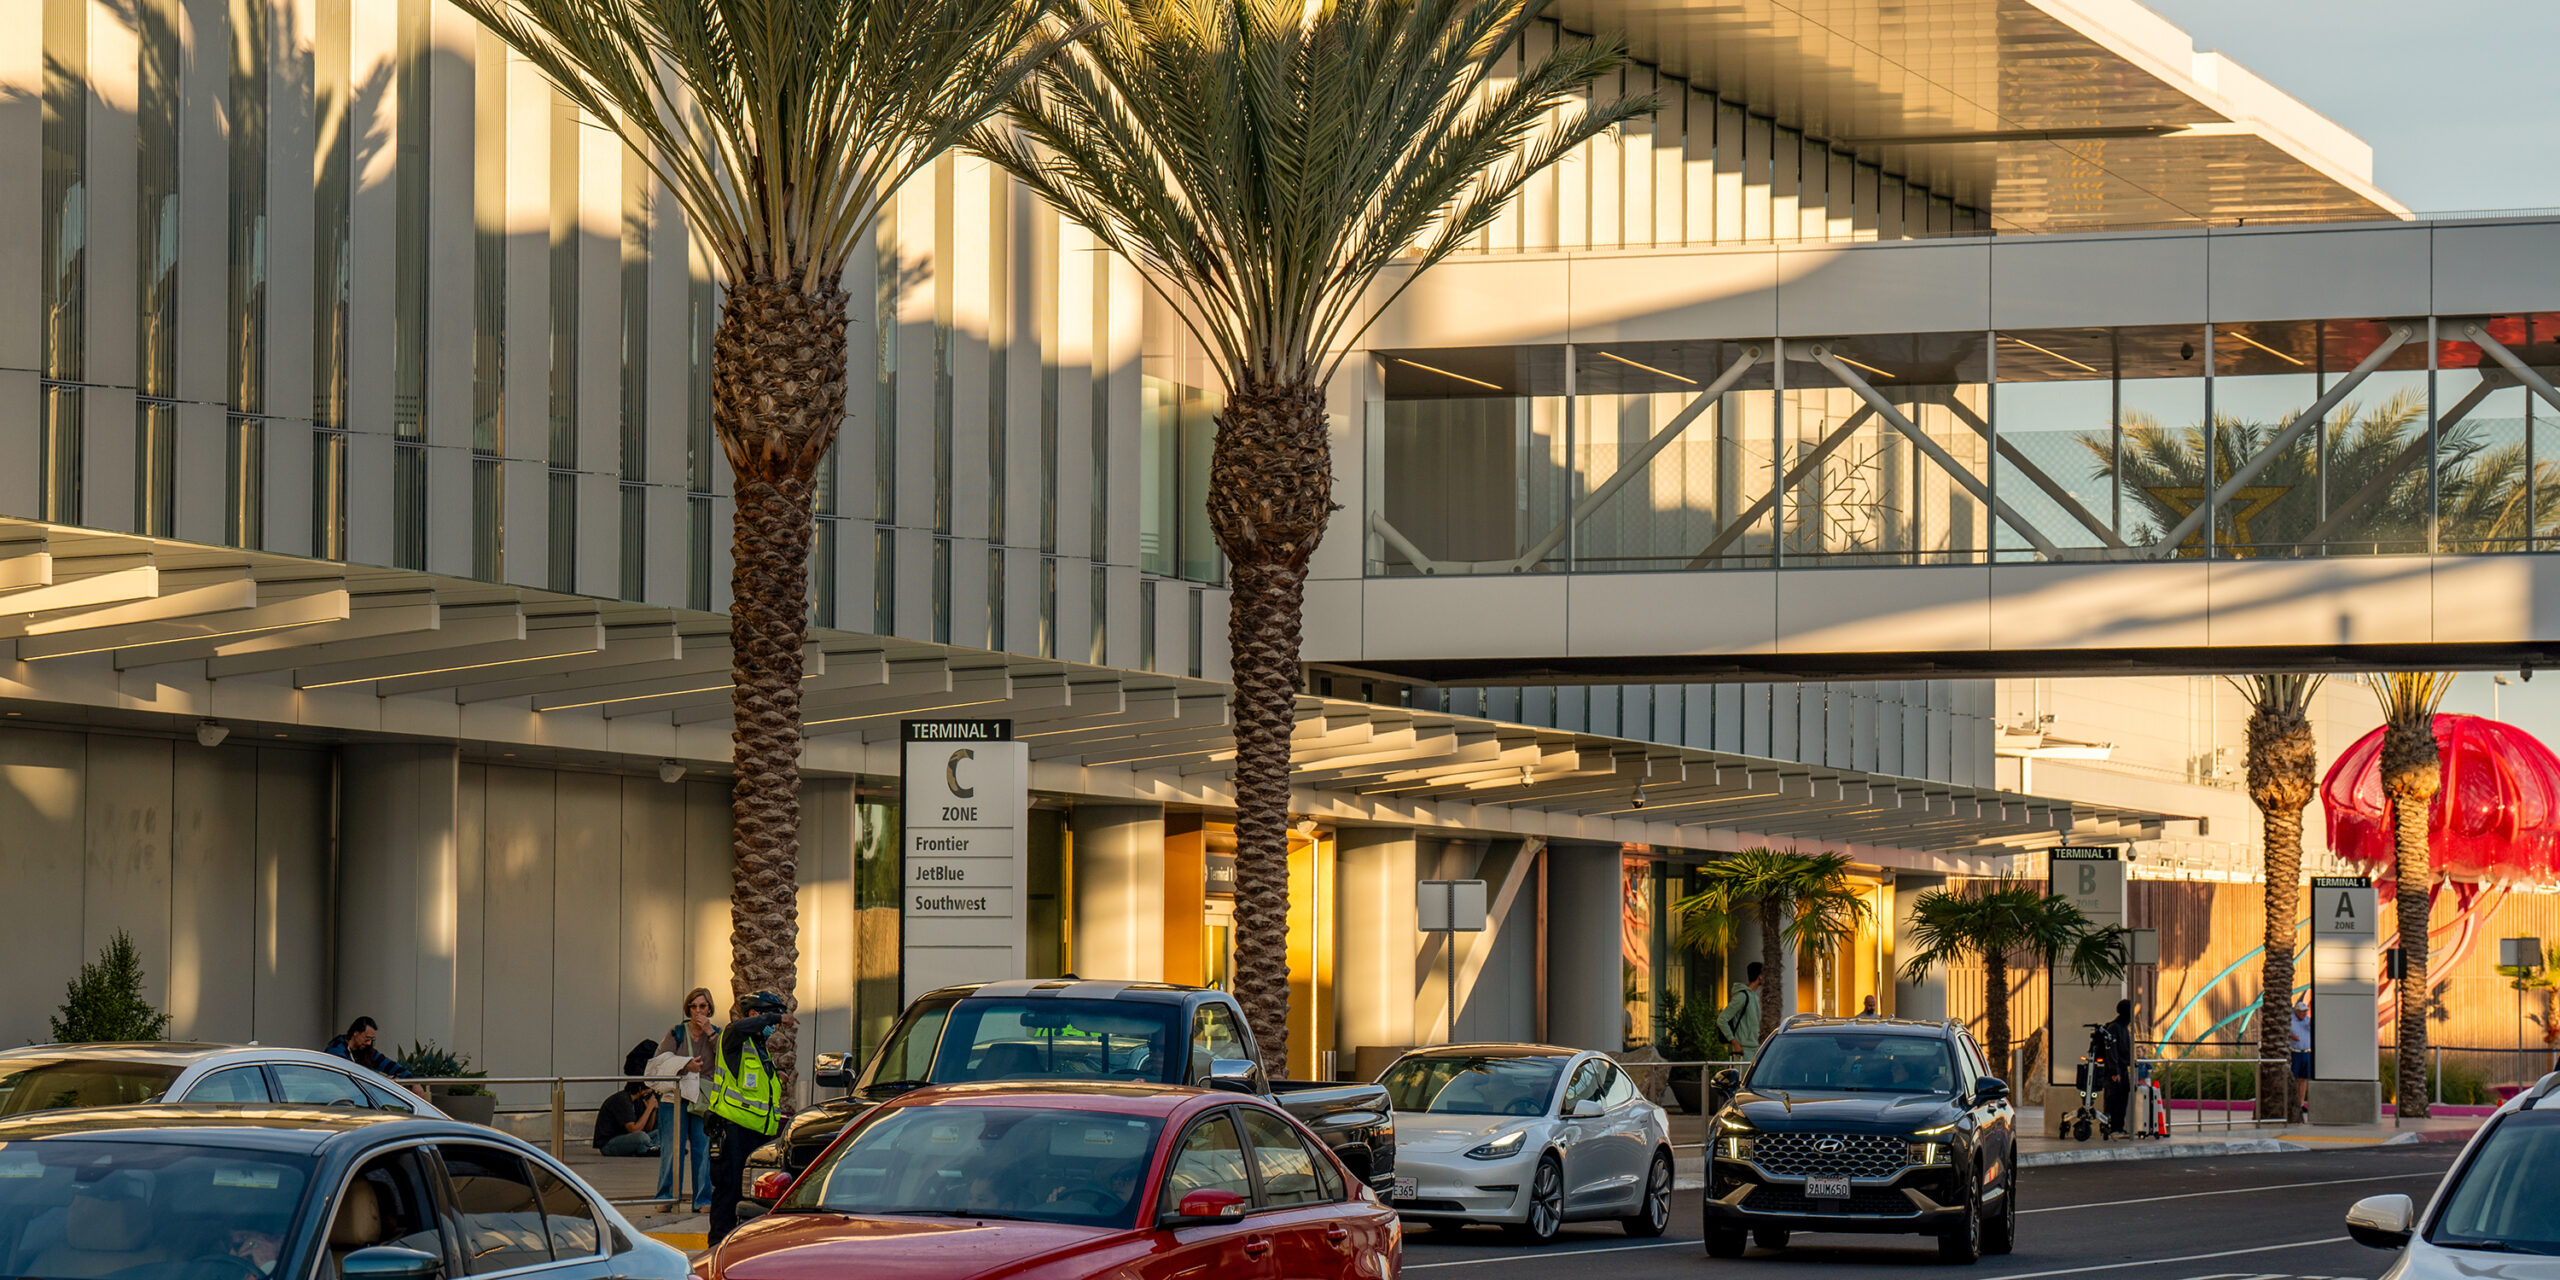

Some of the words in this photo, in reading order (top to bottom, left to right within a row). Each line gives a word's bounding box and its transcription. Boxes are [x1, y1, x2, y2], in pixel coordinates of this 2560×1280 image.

[911, 723, 988, 739] TERMINAL
[993, 723, 1000, 739] 1
[946, 748, 975, 799] C
[941, 806, 978, 821] ZONE
[915, 836, 970, 851] Frontier
[2054, 848, 2104, 859] TERMINAL
[2107, 848, 2112, 859] 1
[915, 866, 965, 881] JetBlue
[2078, 863, 2097, 895] B
[2316, 878, 2360, 887] TERMINAL
[2361, 878, 2366, 887] 1
[915, 895, 987, 911] Southwest
[2334, 891, 2355, 918] A
[2334, 921, 2356, 930] ZONE
